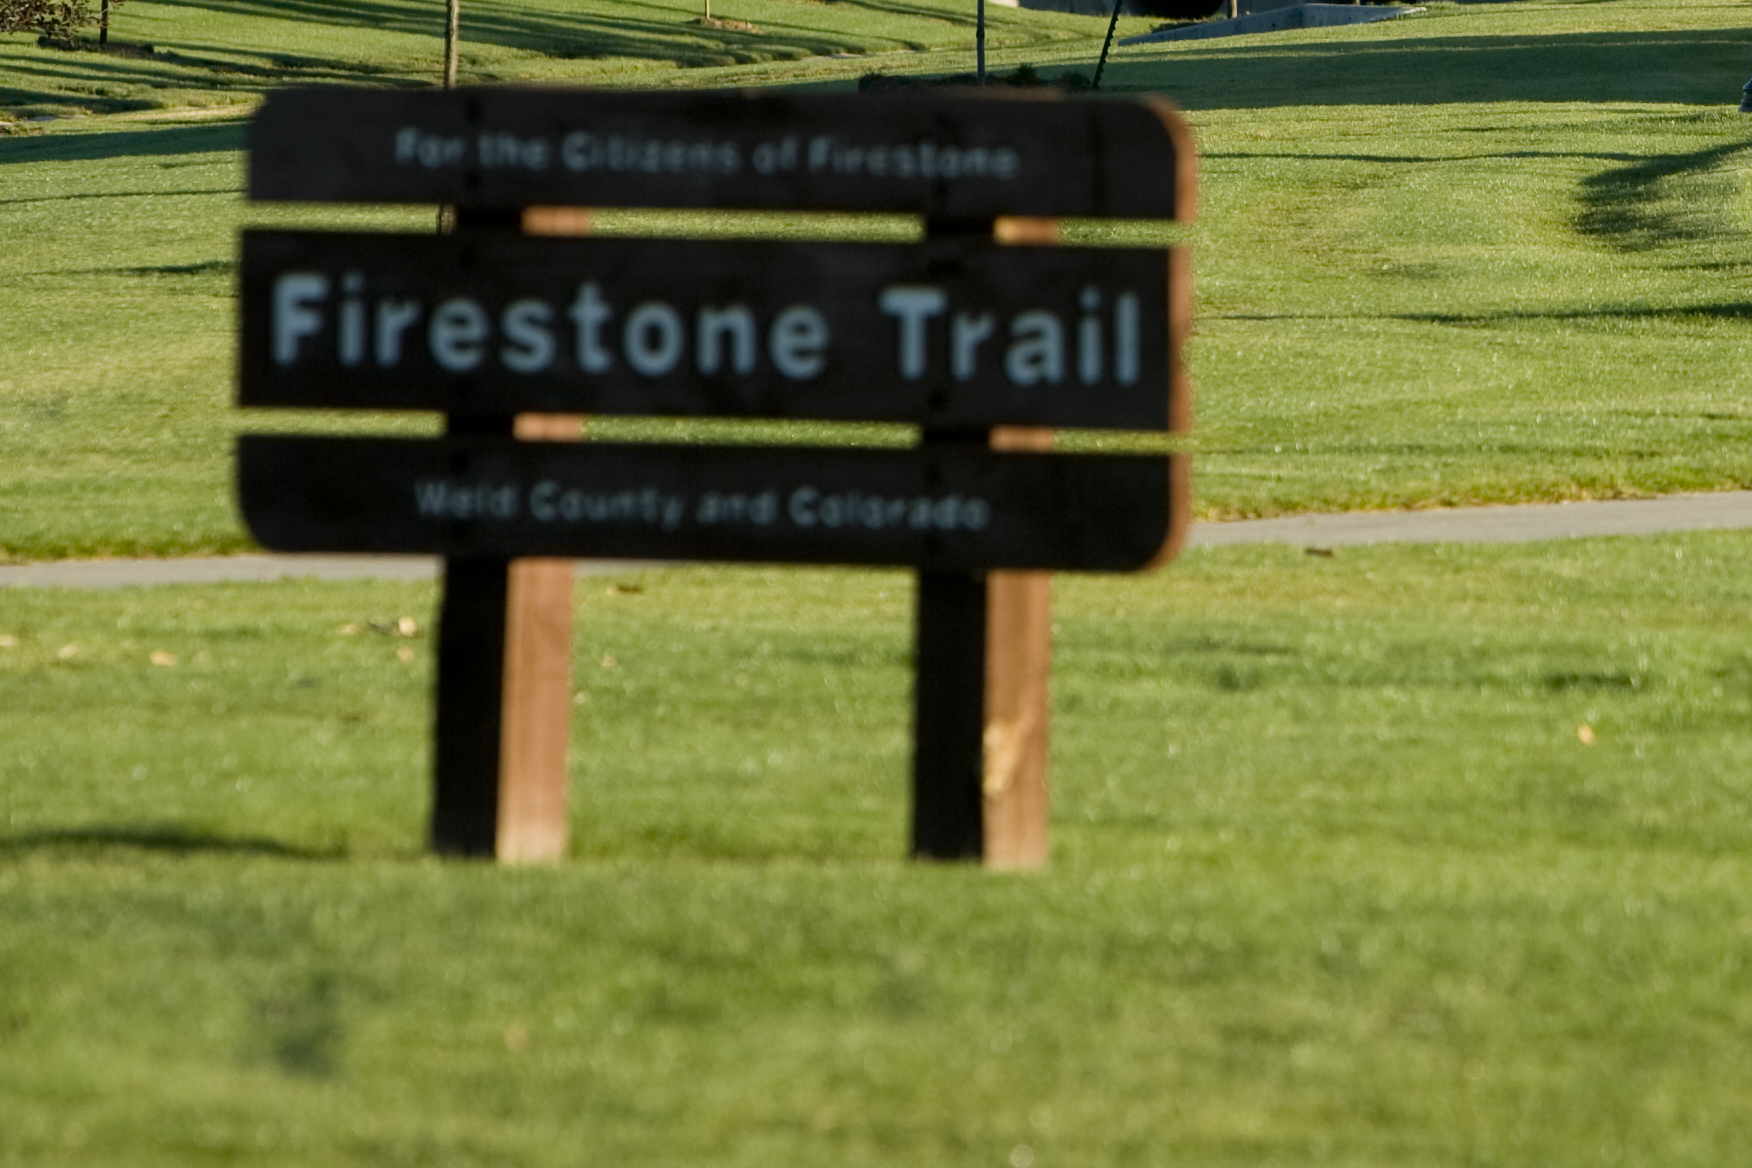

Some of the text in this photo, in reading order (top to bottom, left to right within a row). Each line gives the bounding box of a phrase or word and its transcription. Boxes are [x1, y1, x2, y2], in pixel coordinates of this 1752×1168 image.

[396, 127, 1020, 180] For the Citizens of Firestone
[270, 270, 1142, 388] Firestone Trail
[413, 479, 992, 531] Weld County and Colorado
